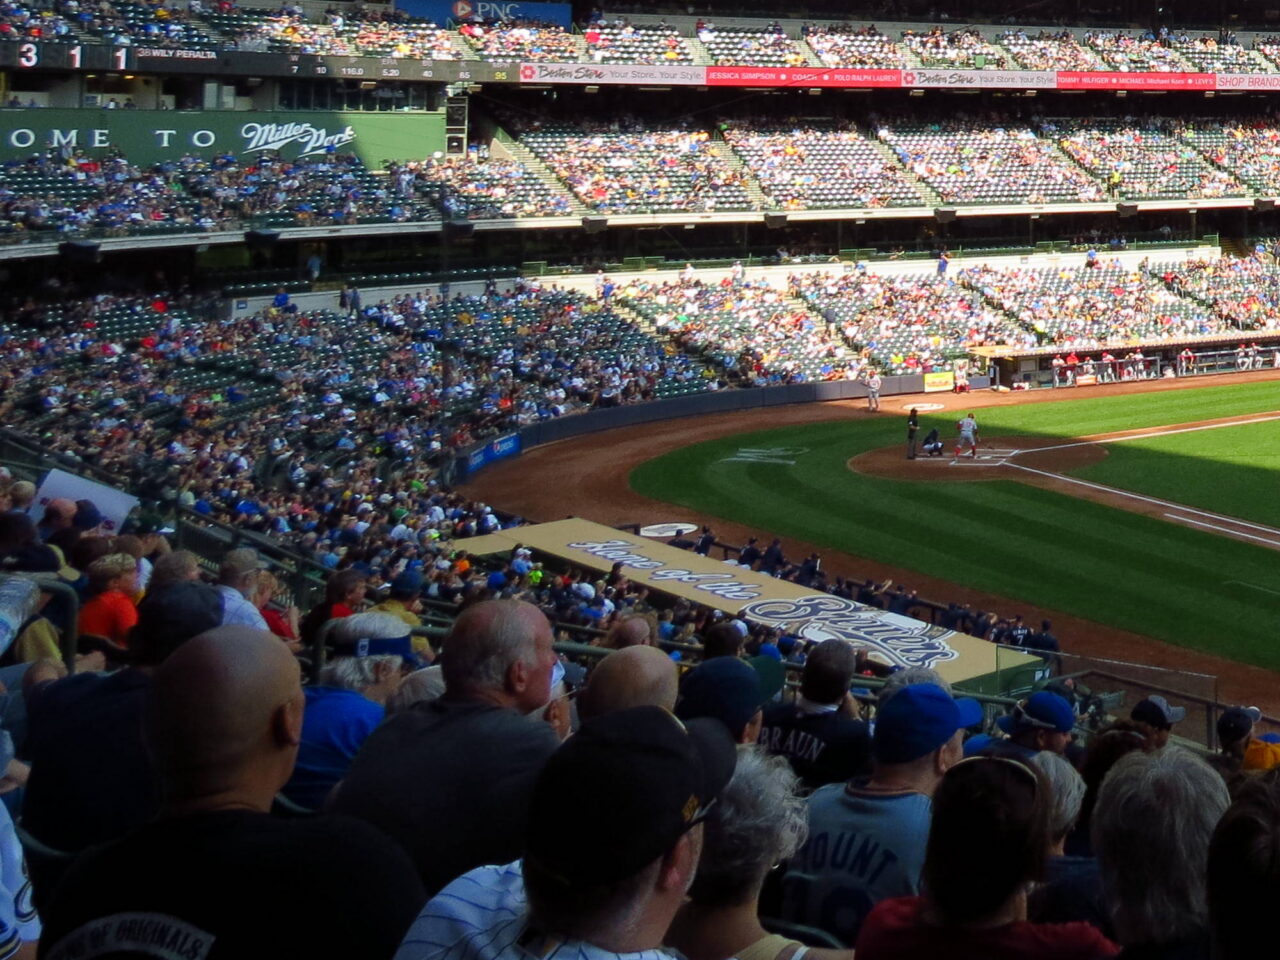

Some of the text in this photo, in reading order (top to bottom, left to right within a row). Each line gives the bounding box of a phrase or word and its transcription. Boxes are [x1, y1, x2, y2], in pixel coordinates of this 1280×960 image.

[477, 3, 520, 19] PNC
[19, 43, 38, 68] 3
[69, 45, 82, 68] 1
[114, 47, 127, 70] 1
[152, 48, 173, 58] WILY
[176, 49, 217, 59] PERALTA
[316, 66, 327, 74] 10
[382, 68, 400, 76] 5.20
[495, 71, 507, 80] 95
[538, 65, 606, 80] Boston Store
[659, 71, 679, 79] Your
[681, 71, 704, 81] Style.
[709, 72, 776, 80] JESSICA SIMPSON
[792, 73, 817, 81] COACH
[917, 72, 976, 84] Boston Store
[1218, 77, 1244, 88] SHOP
[10, 128, 216, 148] OME TO
[241, 122, 358, 158] Miller Park
[568, 540, 665, 569] Home
[694, 582, 763, 600] the
[744, 594, 959, 669] Brewers
[759, 726, 827, 763] BRAUN
[802, 830, 898, 884] OUNT
[114, 918, 204, 960] ORIGINALS
